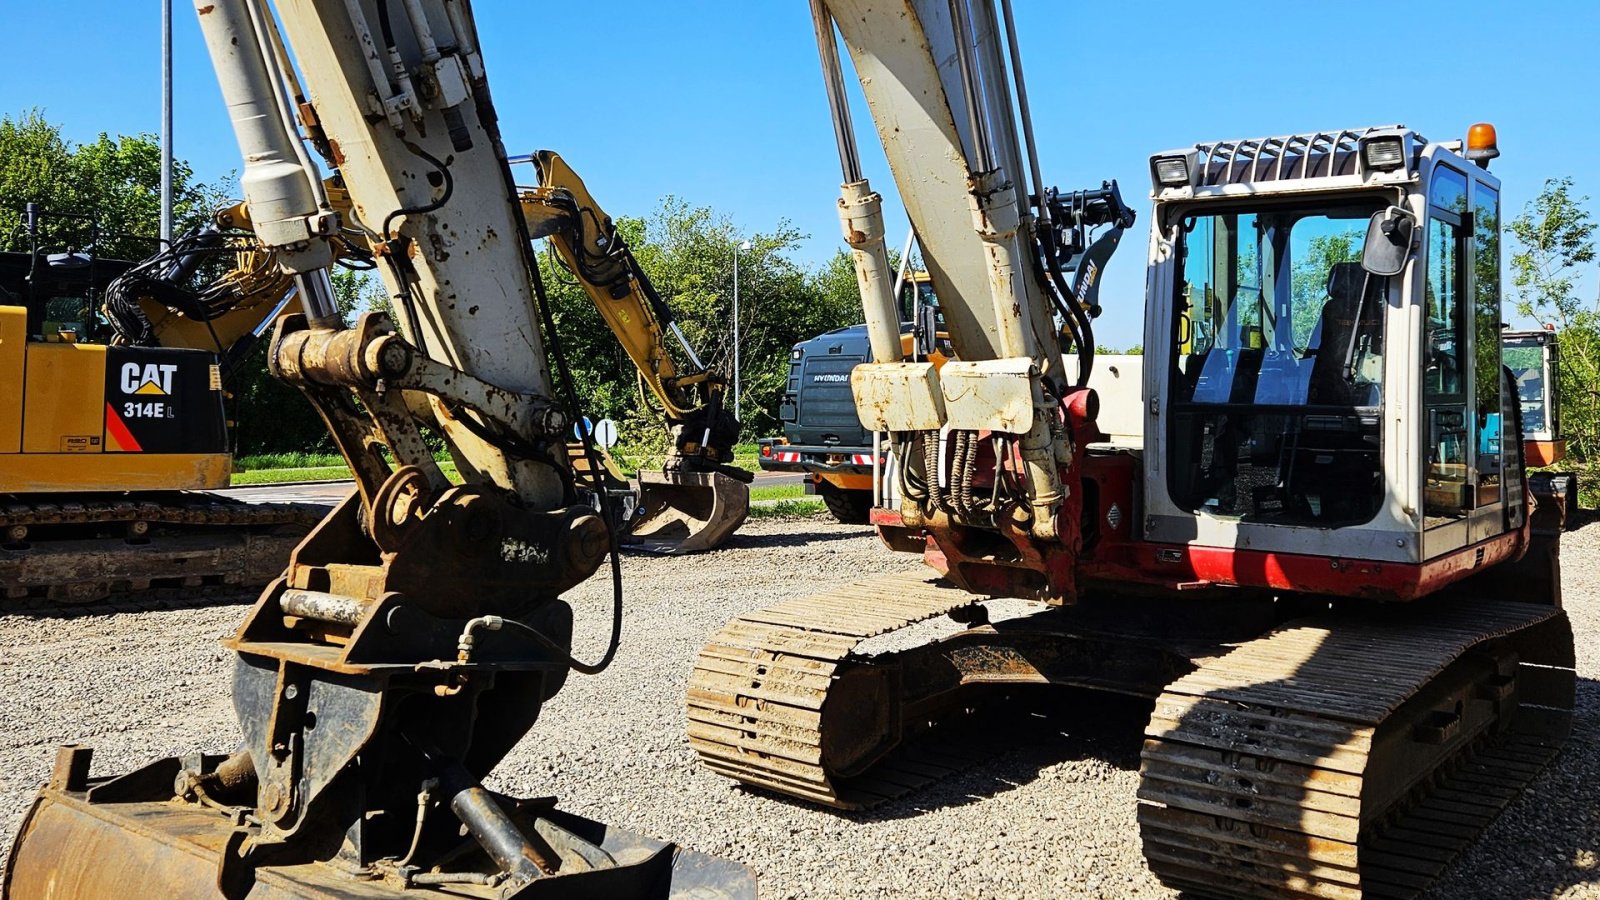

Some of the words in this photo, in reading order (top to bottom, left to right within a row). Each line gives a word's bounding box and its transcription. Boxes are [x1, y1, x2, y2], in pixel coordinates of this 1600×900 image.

[1077, 258, 1096, 303] UNDAI
[120, 362, 178, 395] CAT
[814, 374, 849, 382] HYUNDAI
[124, 402, 164, 418] 314E
